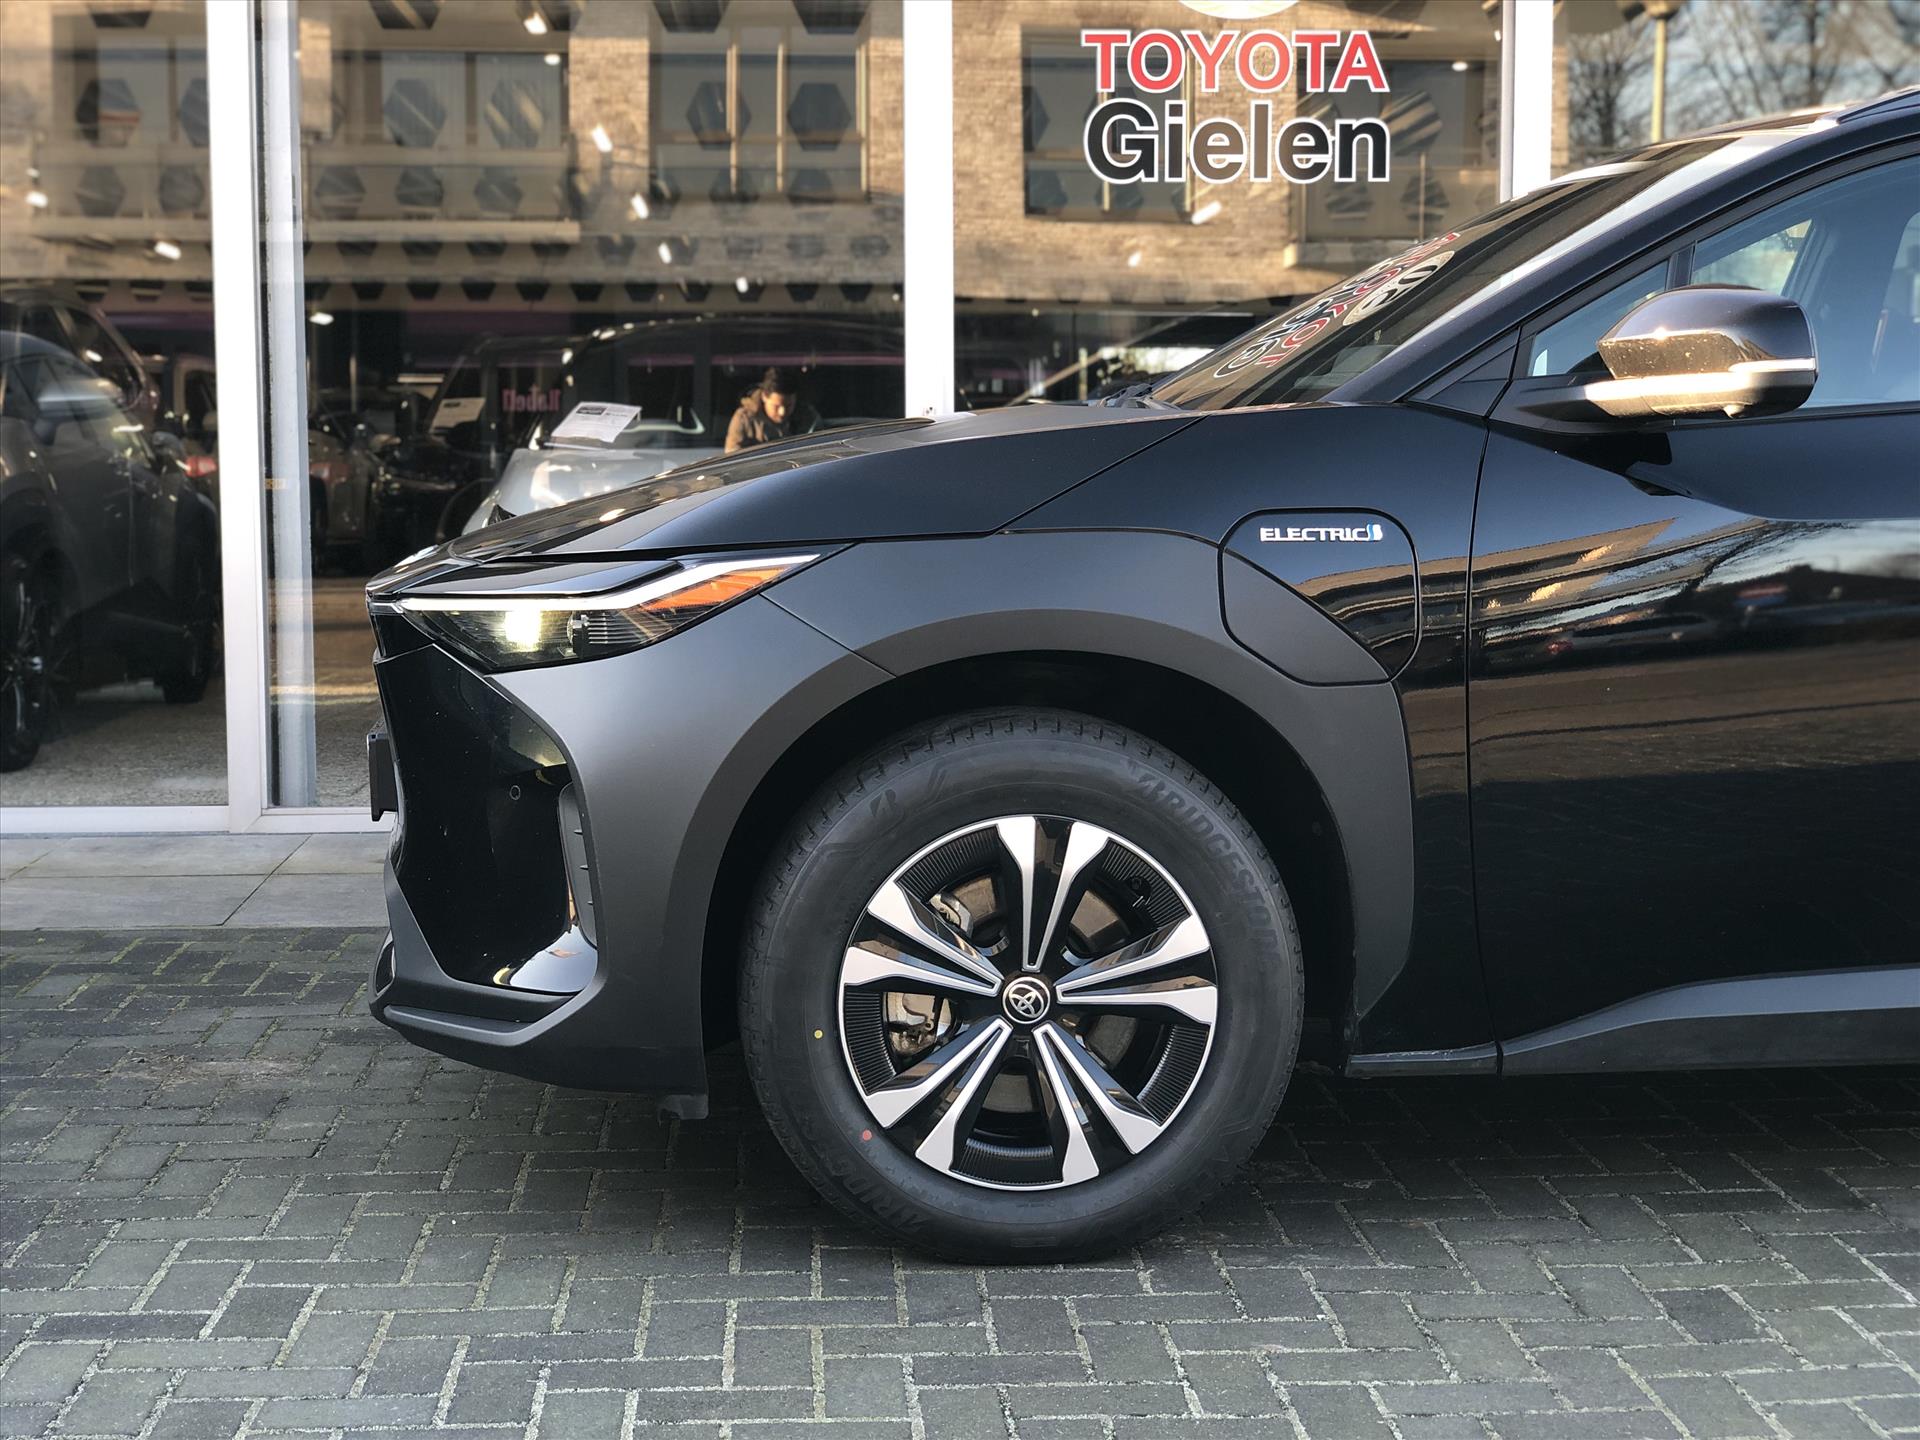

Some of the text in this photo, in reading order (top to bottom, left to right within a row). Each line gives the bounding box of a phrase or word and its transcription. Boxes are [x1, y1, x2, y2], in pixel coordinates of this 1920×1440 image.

[1081, 29, 1390, 93] TOYOTA
[1083, 97, 1390, 185] Gielen
[1260, 527, 1369, 541] ELECTRIC
